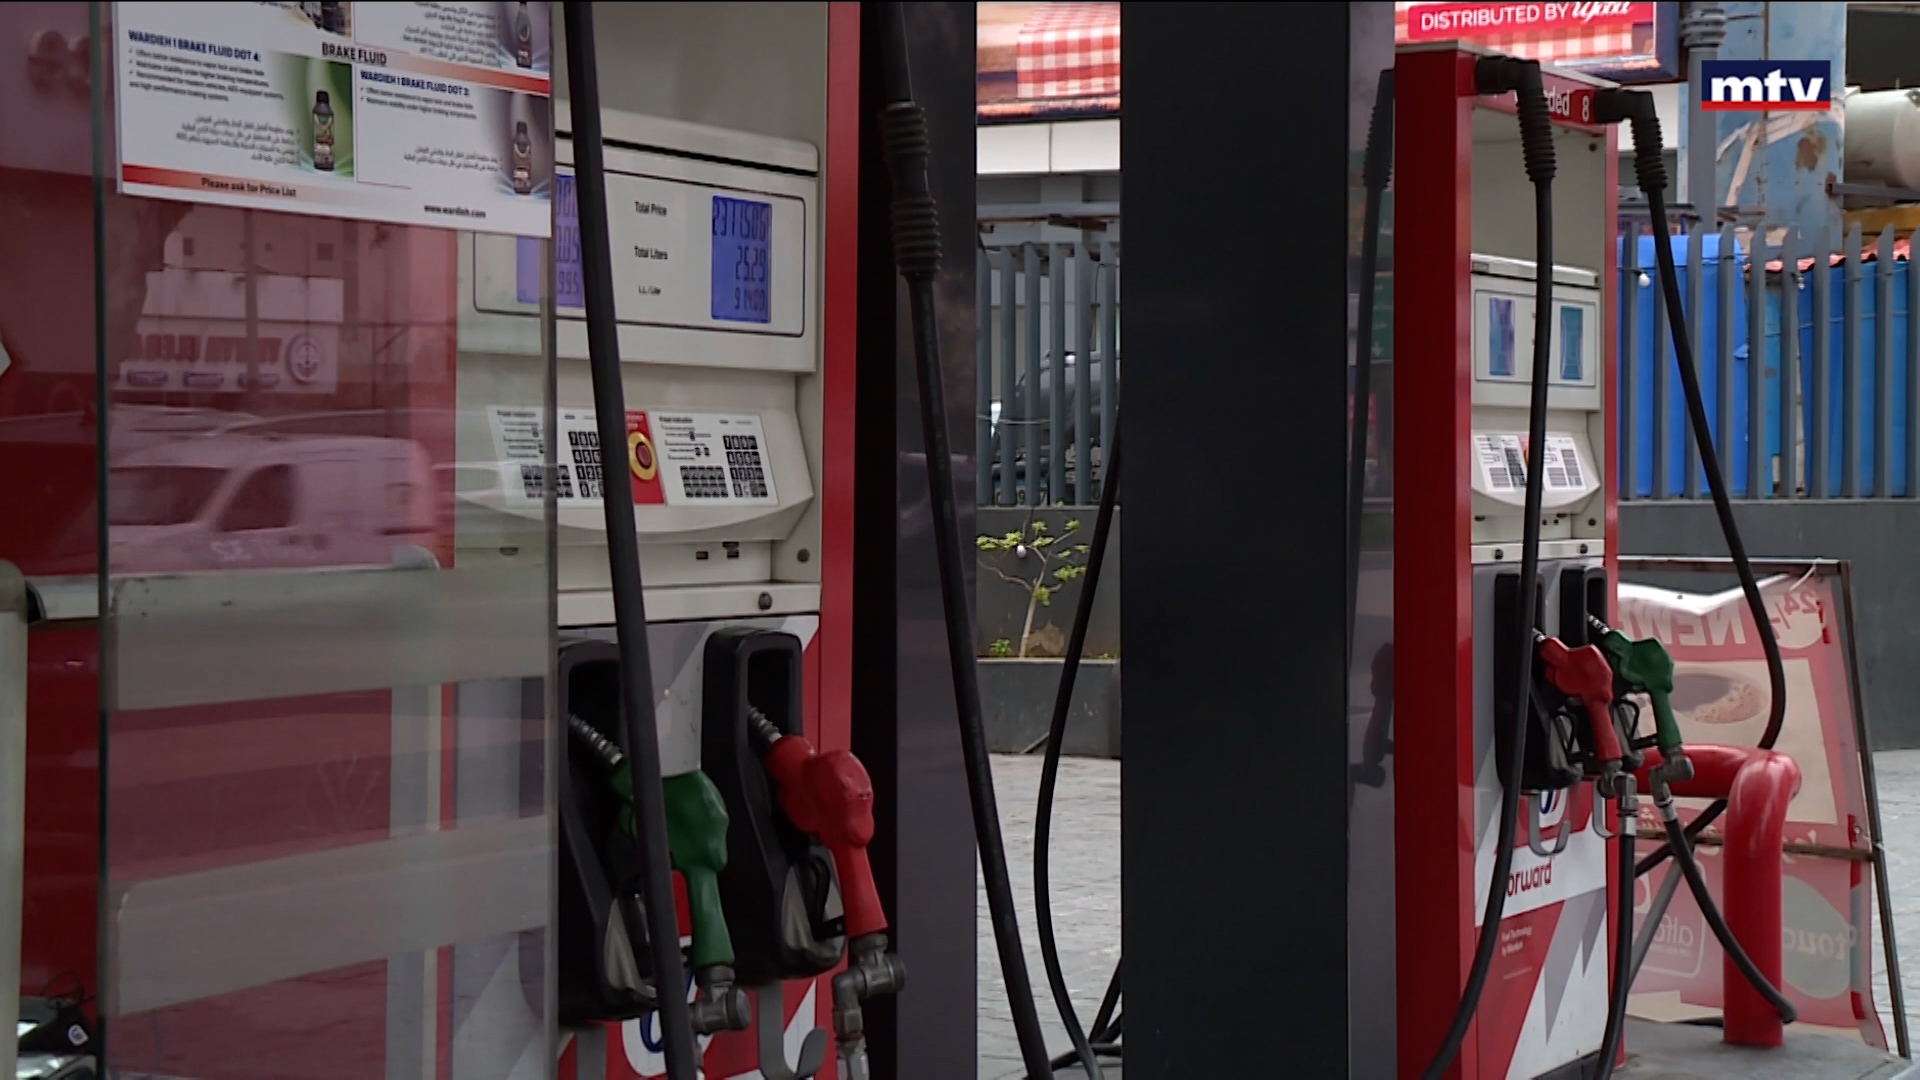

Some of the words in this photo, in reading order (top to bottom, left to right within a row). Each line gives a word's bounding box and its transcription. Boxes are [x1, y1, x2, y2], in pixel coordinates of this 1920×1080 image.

[1420, 5, 1540, 31] DISTRIBUTED
[1544, 2, 1570, 20] BY
[178, 38, 206, 54] BRAKE
[208, 44, 233, 58] FLUID
[234, 49, 252, 61] DOT
[321, 41, 356, 60] BRAKE
[357, 48, 387, 65] FLUID
[201, 177, 229, 191] Please
[231, 181, 244, 192] ask
[247, 183, 258, 193] for
[259, 183, 281, 196] Price
[281, 187, 297, 198] List
[635, 200, 650, 214] Total
[650, 203, 668, 217] Price
[634, 245, 649, 259] Total
[1505, 856, 1552, 897] orward
